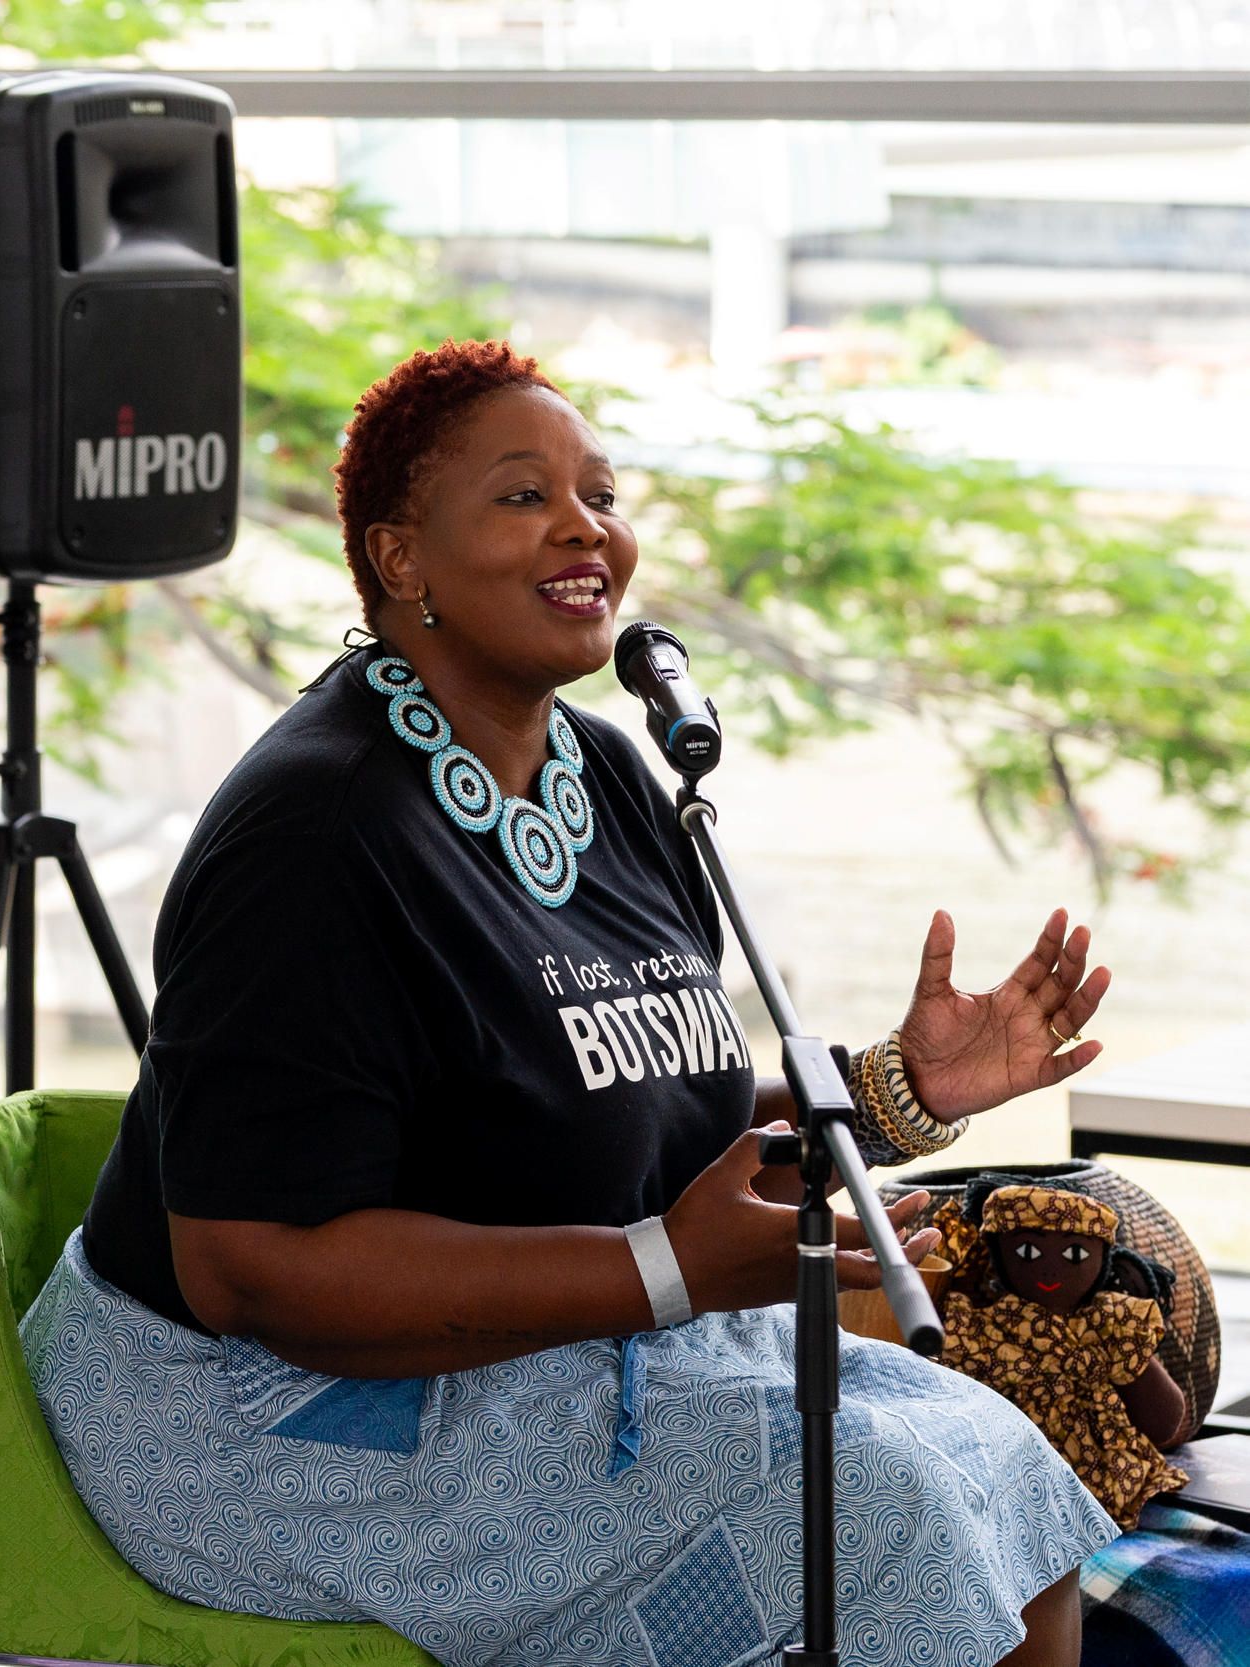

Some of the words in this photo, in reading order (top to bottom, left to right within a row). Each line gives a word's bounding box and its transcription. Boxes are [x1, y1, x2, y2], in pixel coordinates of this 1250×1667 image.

[538, 954, 564, 996] if
[564, 954, 631, 992] lost,
[632, 948, 713, 985] return
